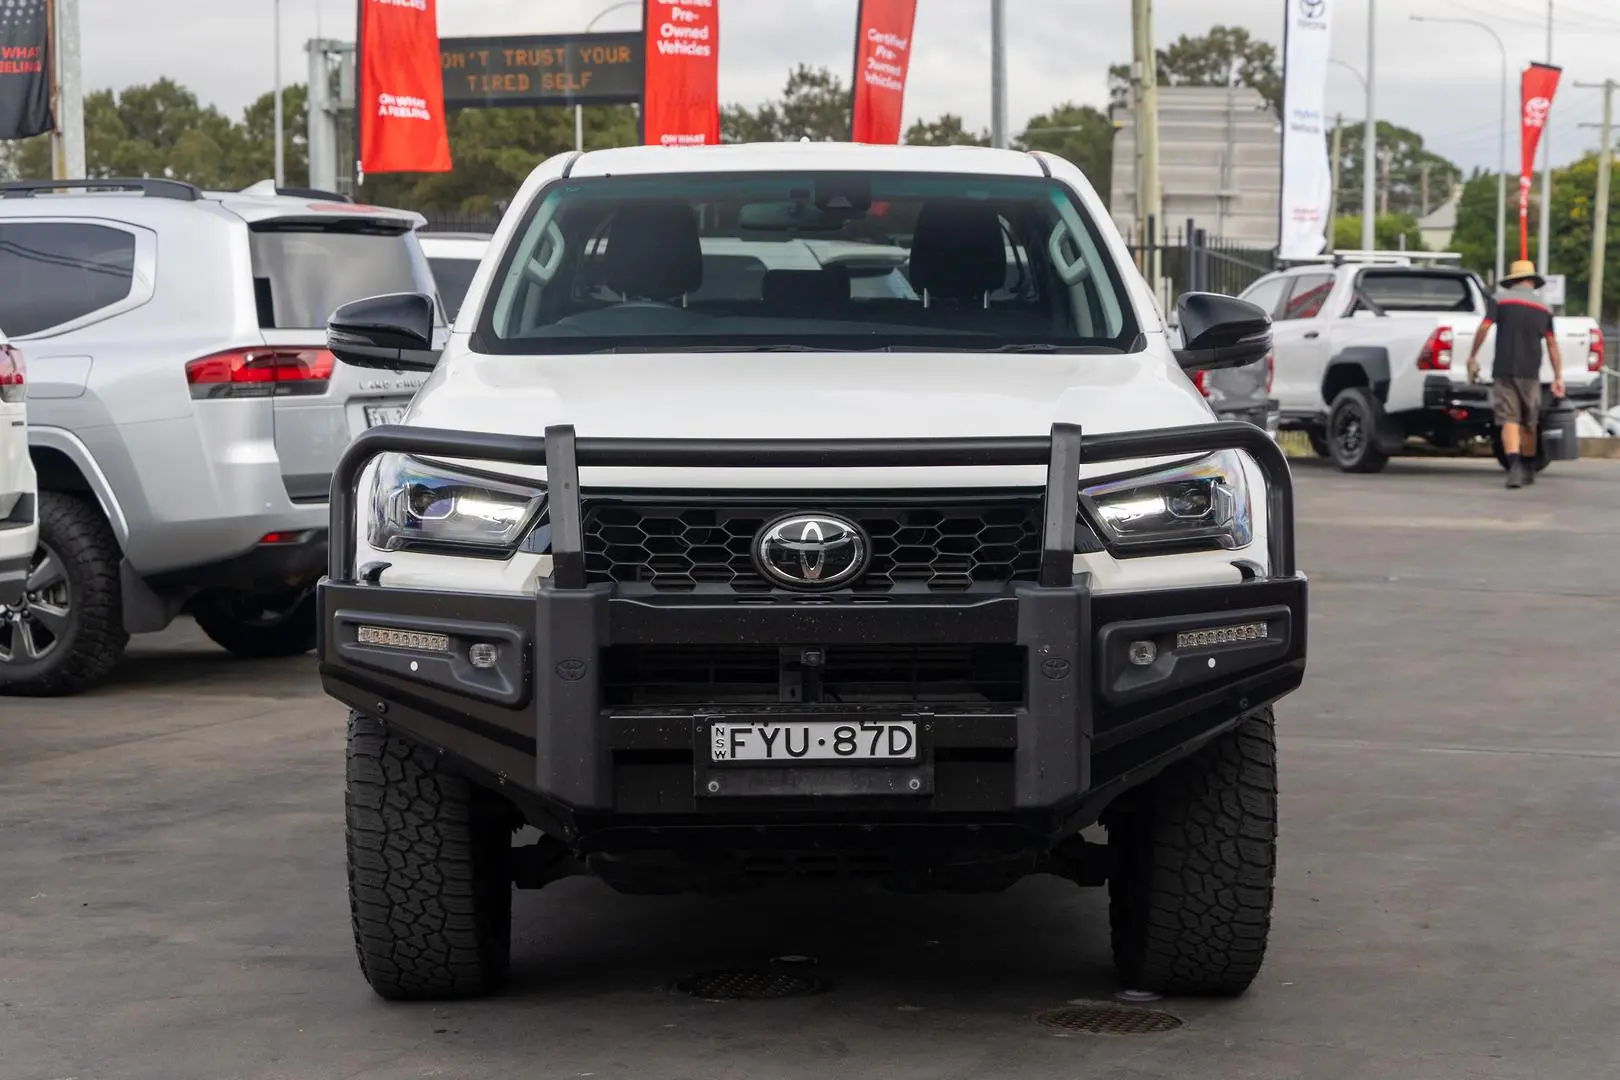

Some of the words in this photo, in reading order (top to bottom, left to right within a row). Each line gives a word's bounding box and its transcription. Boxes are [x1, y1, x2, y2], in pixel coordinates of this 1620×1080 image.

[672, 6, 699, 22] Pre-
[660, 22, 709, 40] Owned
[867, 27, 908, 51] Certified
[441, 51, 490, 69] ON'T
[504, 48, 566, 67] TRUST
[580, 46, 632, 65] YOUR
[657, 40, 711, 56] Vehicles
[467, 74, 531, 92] TIRED
[542, 71, 593, 90] SELF
